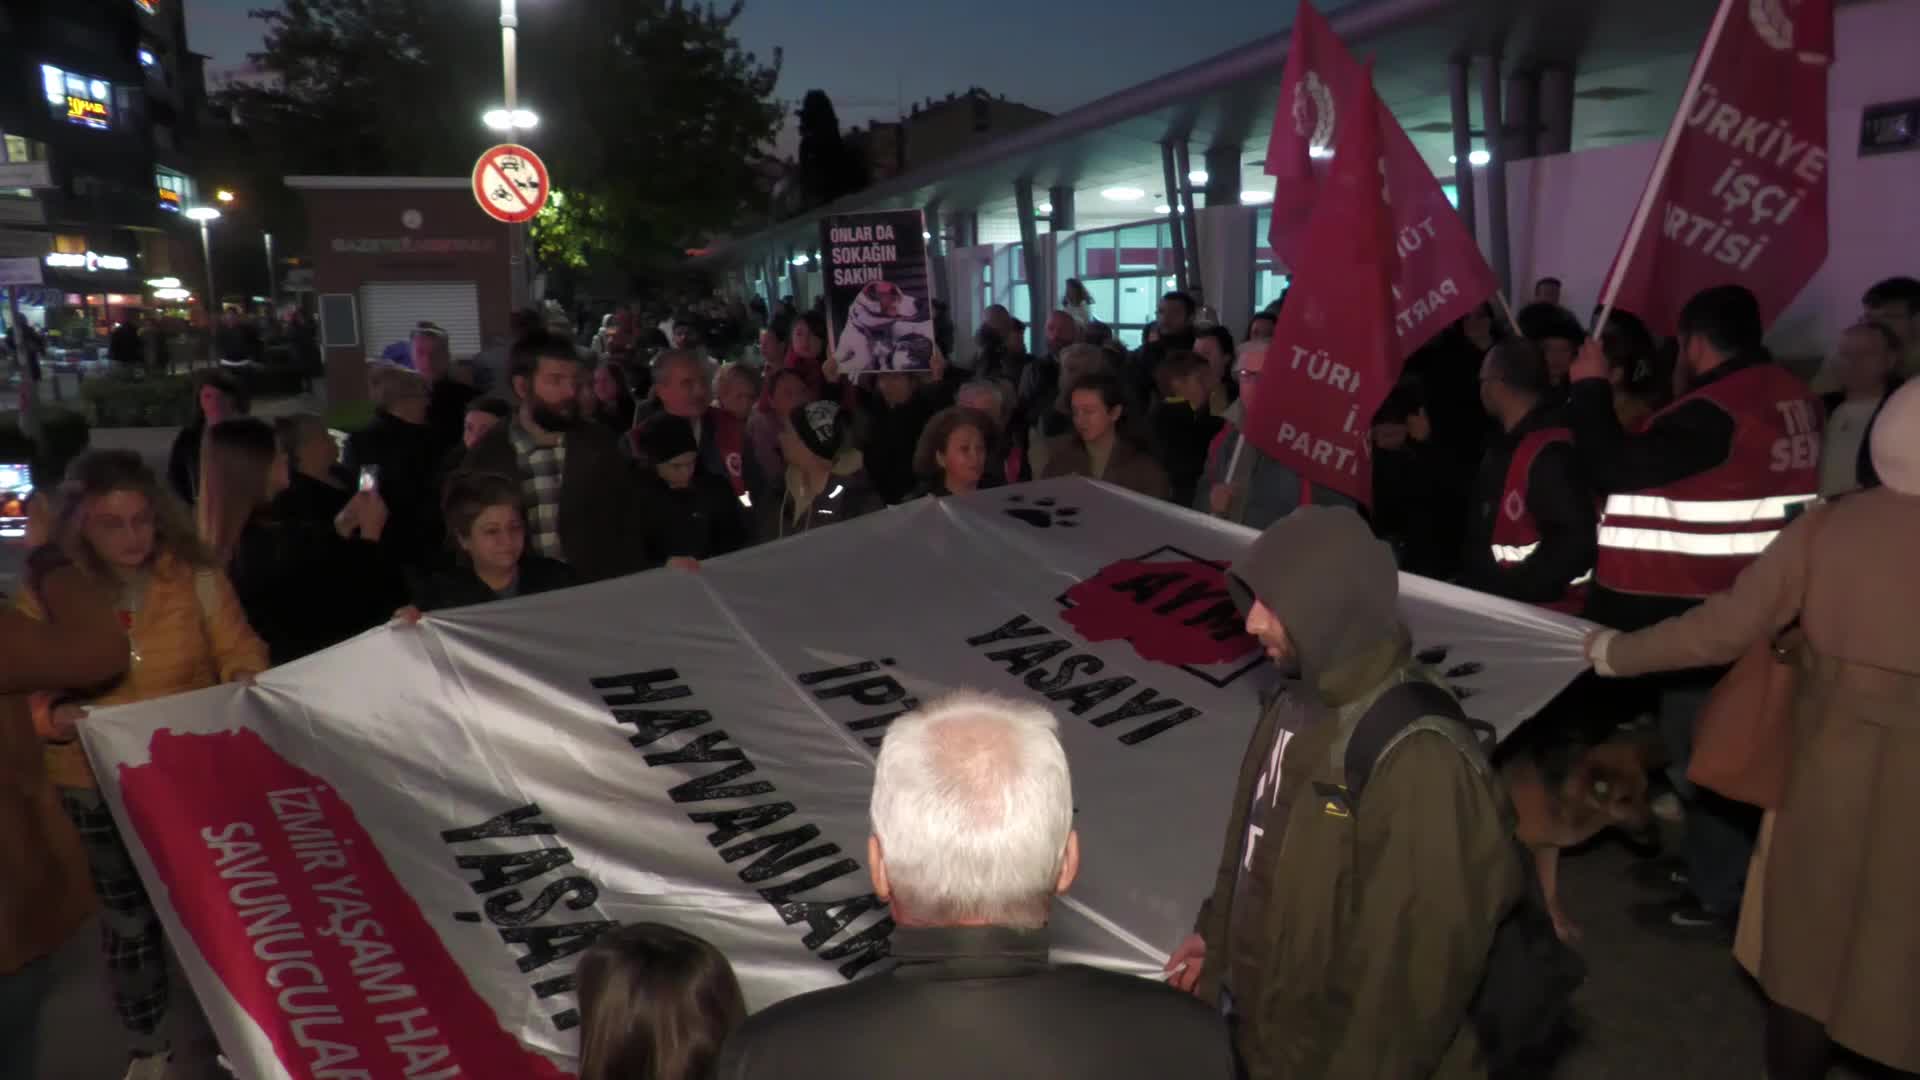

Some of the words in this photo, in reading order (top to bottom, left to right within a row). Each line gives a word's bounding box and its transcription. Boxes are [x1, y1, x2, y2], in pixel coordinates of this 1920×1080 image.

[1687, 83, 1827, 184] ÜRKİYE
[830, 226, 872, 243] ONLAR
[875, 225, 895, 241] DA
[1711, 158, 1806, 225] İŞÇİ
[831, 242, 897, 265] SOKAĞIN
[1663, 201, 1770, 271] RTİSİ
[966, 612, 1203, 746] YASAYI
[266, 784, 348, 873] İZMİR
[311, 873, 417, 1004] YAŞAM
[440, 802, 621, 1031] YAŞA
